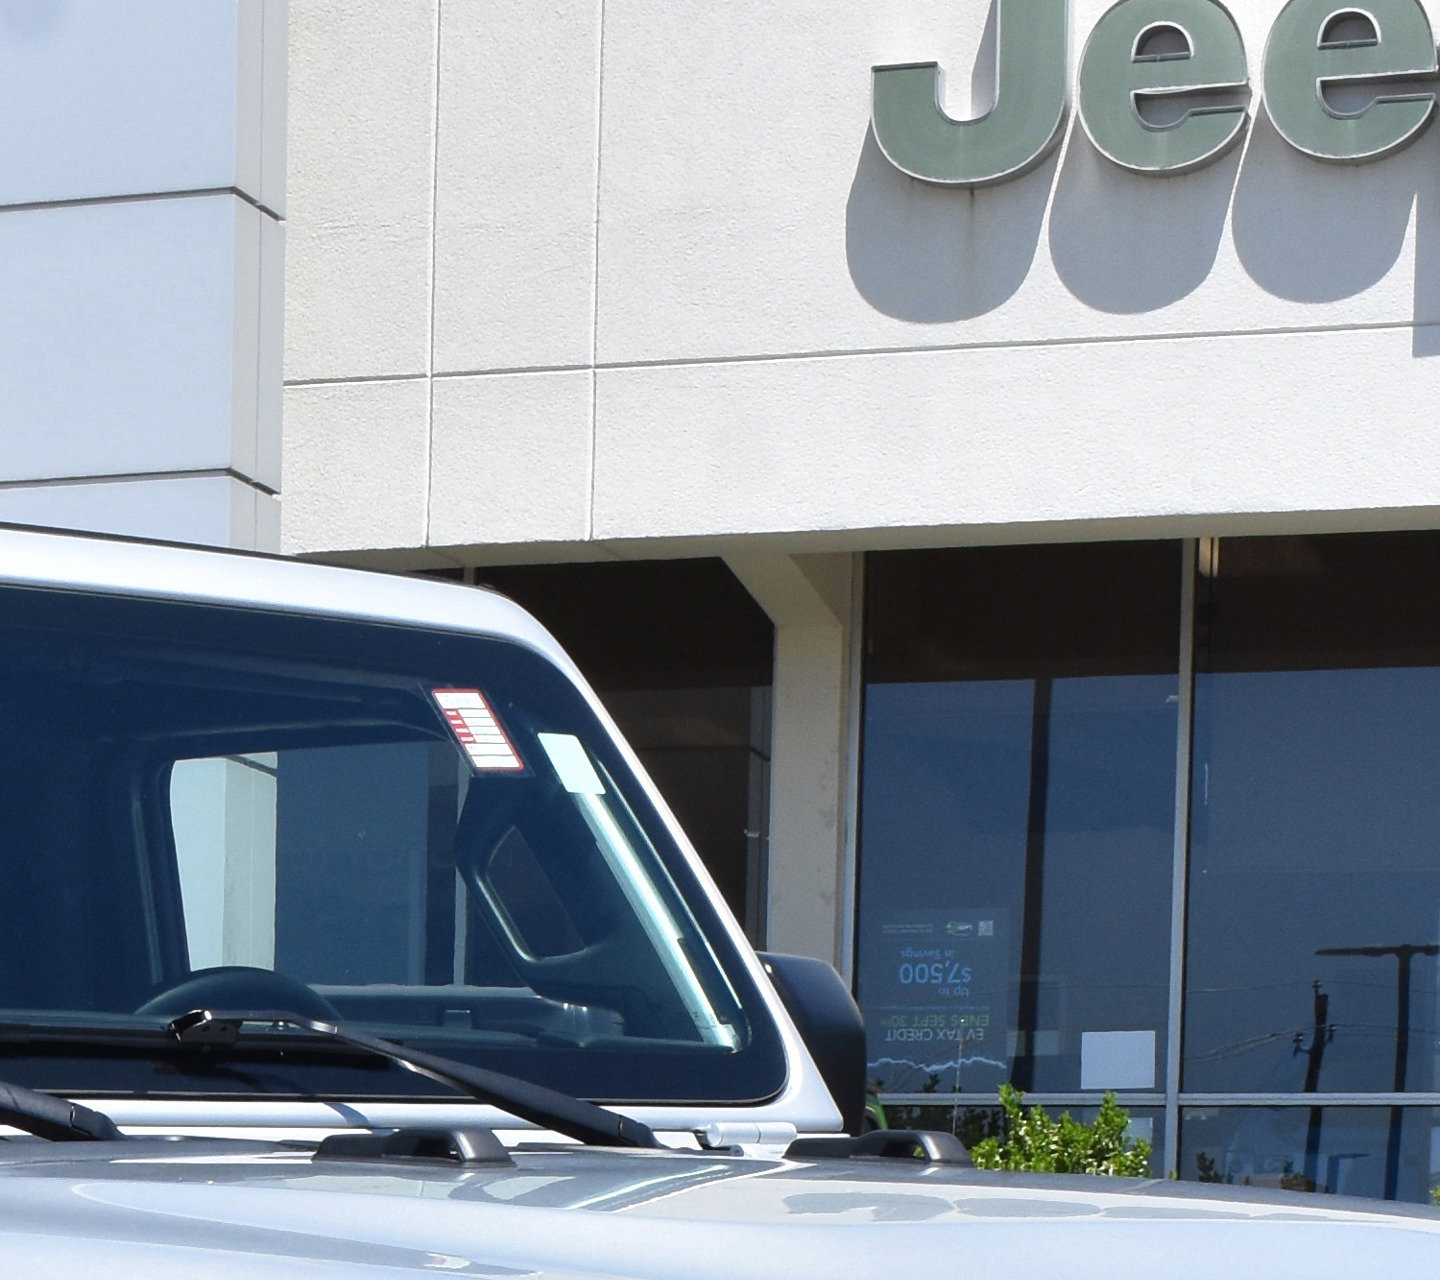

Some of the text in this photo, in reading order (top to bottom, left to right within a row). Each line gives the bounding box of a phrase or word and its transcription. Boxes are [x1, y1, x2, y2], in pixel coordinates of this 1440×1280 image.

[899, 960, 972, 984] $7,500
[912, 1014, 946, 1027] SEPT
[884, 1028, 984, 1041] EV TAX CREDIT
